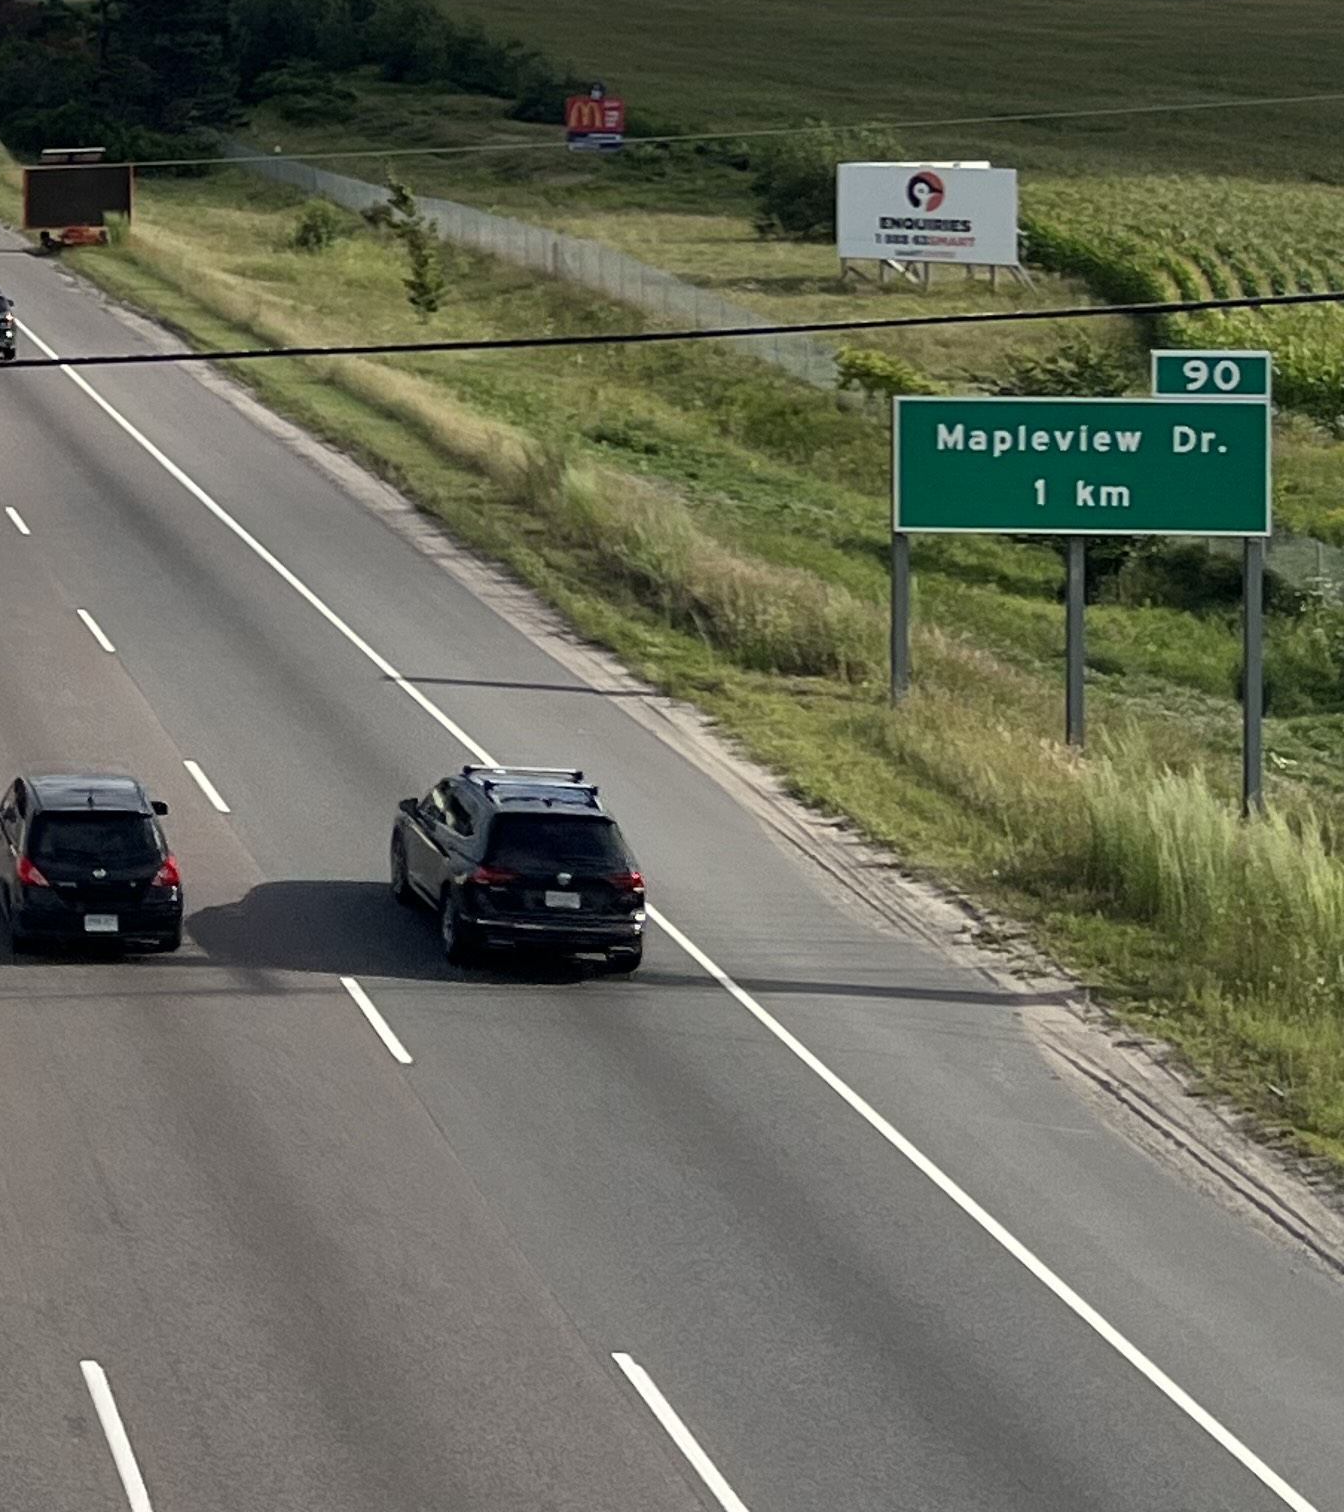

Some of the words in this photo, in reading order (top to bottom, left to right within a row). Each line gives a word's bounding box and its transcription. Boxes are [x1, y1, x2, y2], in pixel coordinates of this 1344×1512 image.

[878, 217, 972, 232] ENQUIRIES
[1182, 360, 1241, 390] 90
[936, 424, 1142, 457] Mapleview
[1172, 425, 1227, 453] Dr.
[1034, 479, 1046, 506] 1
[1076, 479, 1130, 506] km
